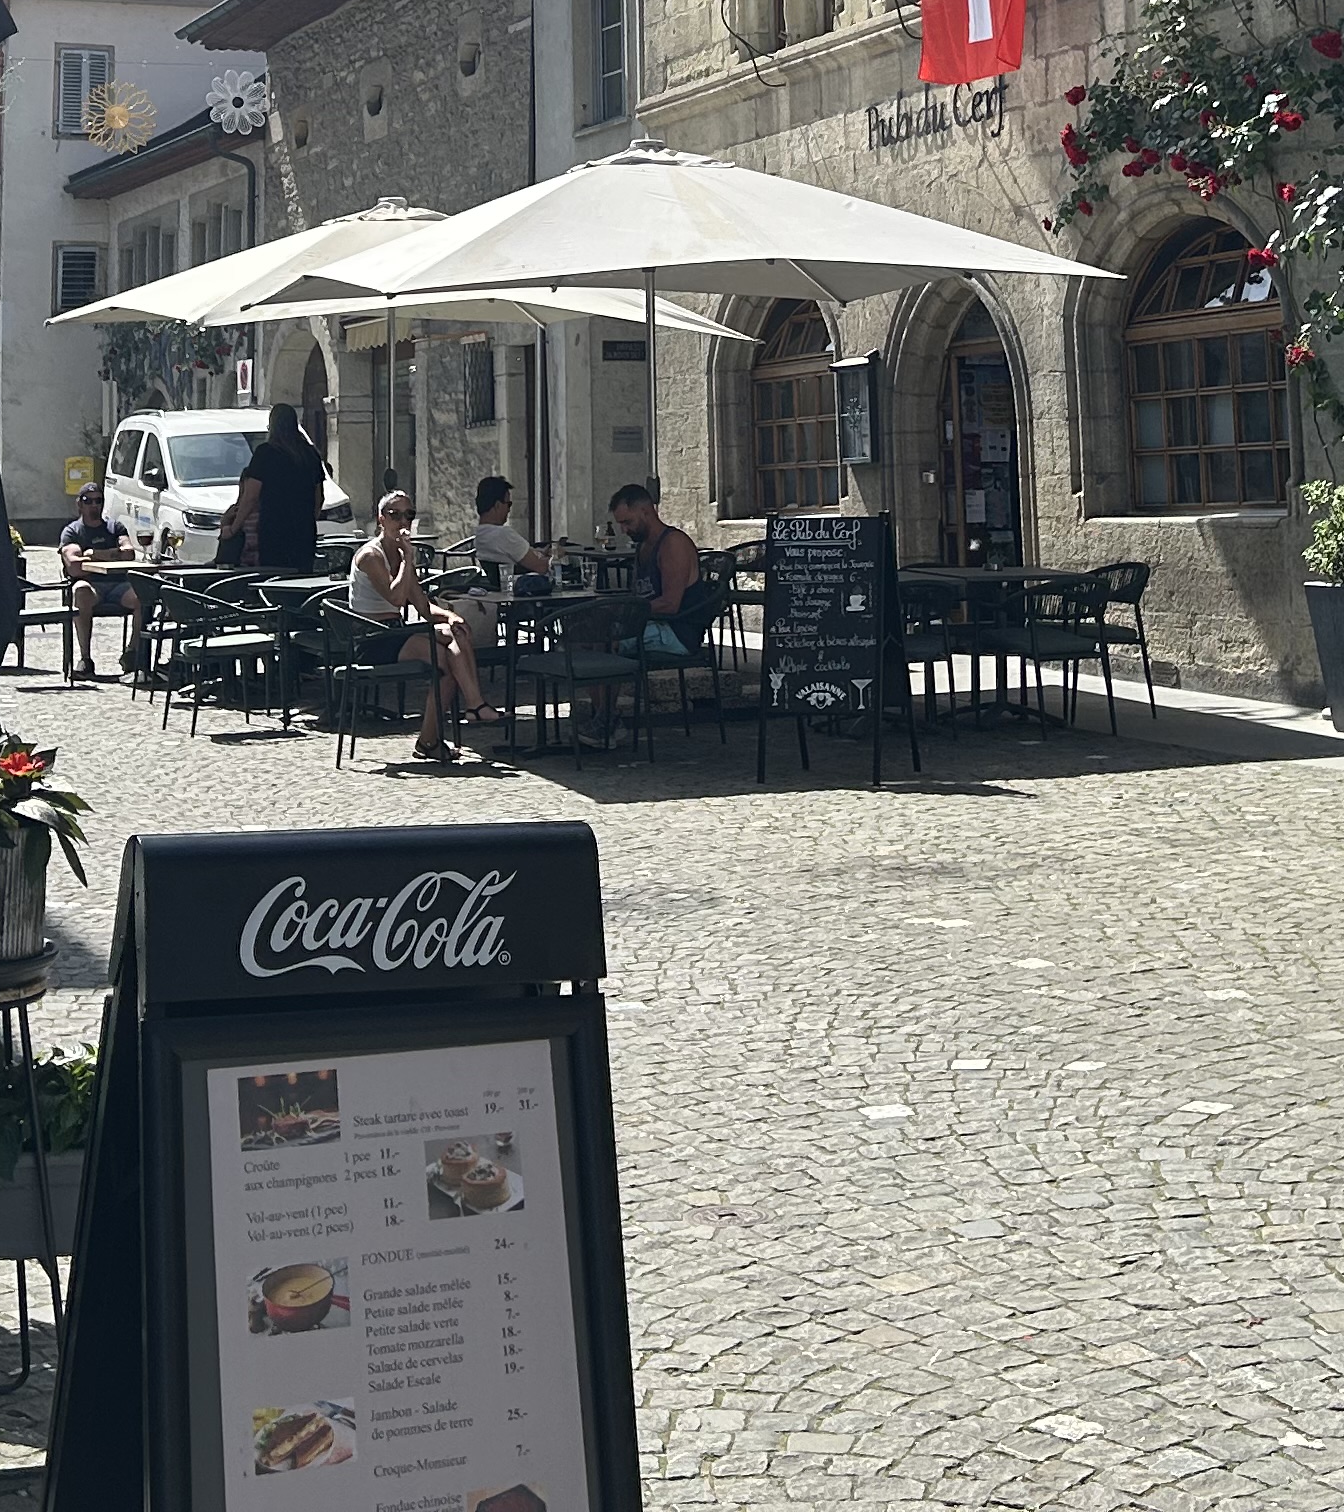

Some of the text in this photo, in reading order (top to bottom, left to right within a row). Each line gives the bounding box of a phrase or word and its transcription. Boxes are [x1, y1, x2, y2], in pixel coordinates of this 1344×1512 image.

[865, 74, 1009, 151] Pub du Cerf
[790, 520, 813, 540] Pub
[815, 519, 829, 539] du
[832, 519, 860, 550] Cerf
[795, 682, 847, 701] VALAISANNE
[240, 870, 517, 977] Coca-Cola
[353, 1099, 539, 1128] Steak tartare avec toast 19.- 31.-
[244, 1160, 280, 1174] Croûte
[352, 1152, 370, 1166] pce
[380, 1148, 400, 1160] 11.-
[244, 1181, 264, 1191] aux
[266, 1172, 337, 1189] champignons
[344, 1169, 352, 1181] 2
[354, 1169, 377, 1183] pces
[246, 1208, 309, 1224] Vol-au-vent
[324, 1203, 348, 1220] pce)
[384, 1198, 403, 1209] 11.-
[247, 1226, 309, 1242] Vol-au-vent
[326, 1220, 354, 1237] pces)
[385, 1215, 405, 1227] 18.-
[361, 1248, 415, 1266] FONDUE
[494, 1238, 515, 1250] 24.-
[363, 1272, 517, 1302] Grande salade mêlée 15.-
[364, 1290, 519, 1320] Petite salade mêlée 8.-
[365, 1308, 520, 1338] Petite salade verte 7.-
[366, 1326, 522, 1357] Tomate mozzarella 18.-
[367, 1344, 523, 1375] Salade de cervelas 18.-
[368, 1362, 525, 1393] Salade Escale 19.-
[370, 1407, 412, 1422] Jambon
[421, 1399, 458, 1415] Salade
[507, 1408, 528, 1421] 25.-
[371, 1417, 474, 1441] de pommes de terre
[516, 1444, 531, 1457] 7.-
[373, 1454, 468, 1478] Croque-Monsieur
[375, 1499, 415, 1512] Fondue
[417, 1492, 462, 1509] chinoise
